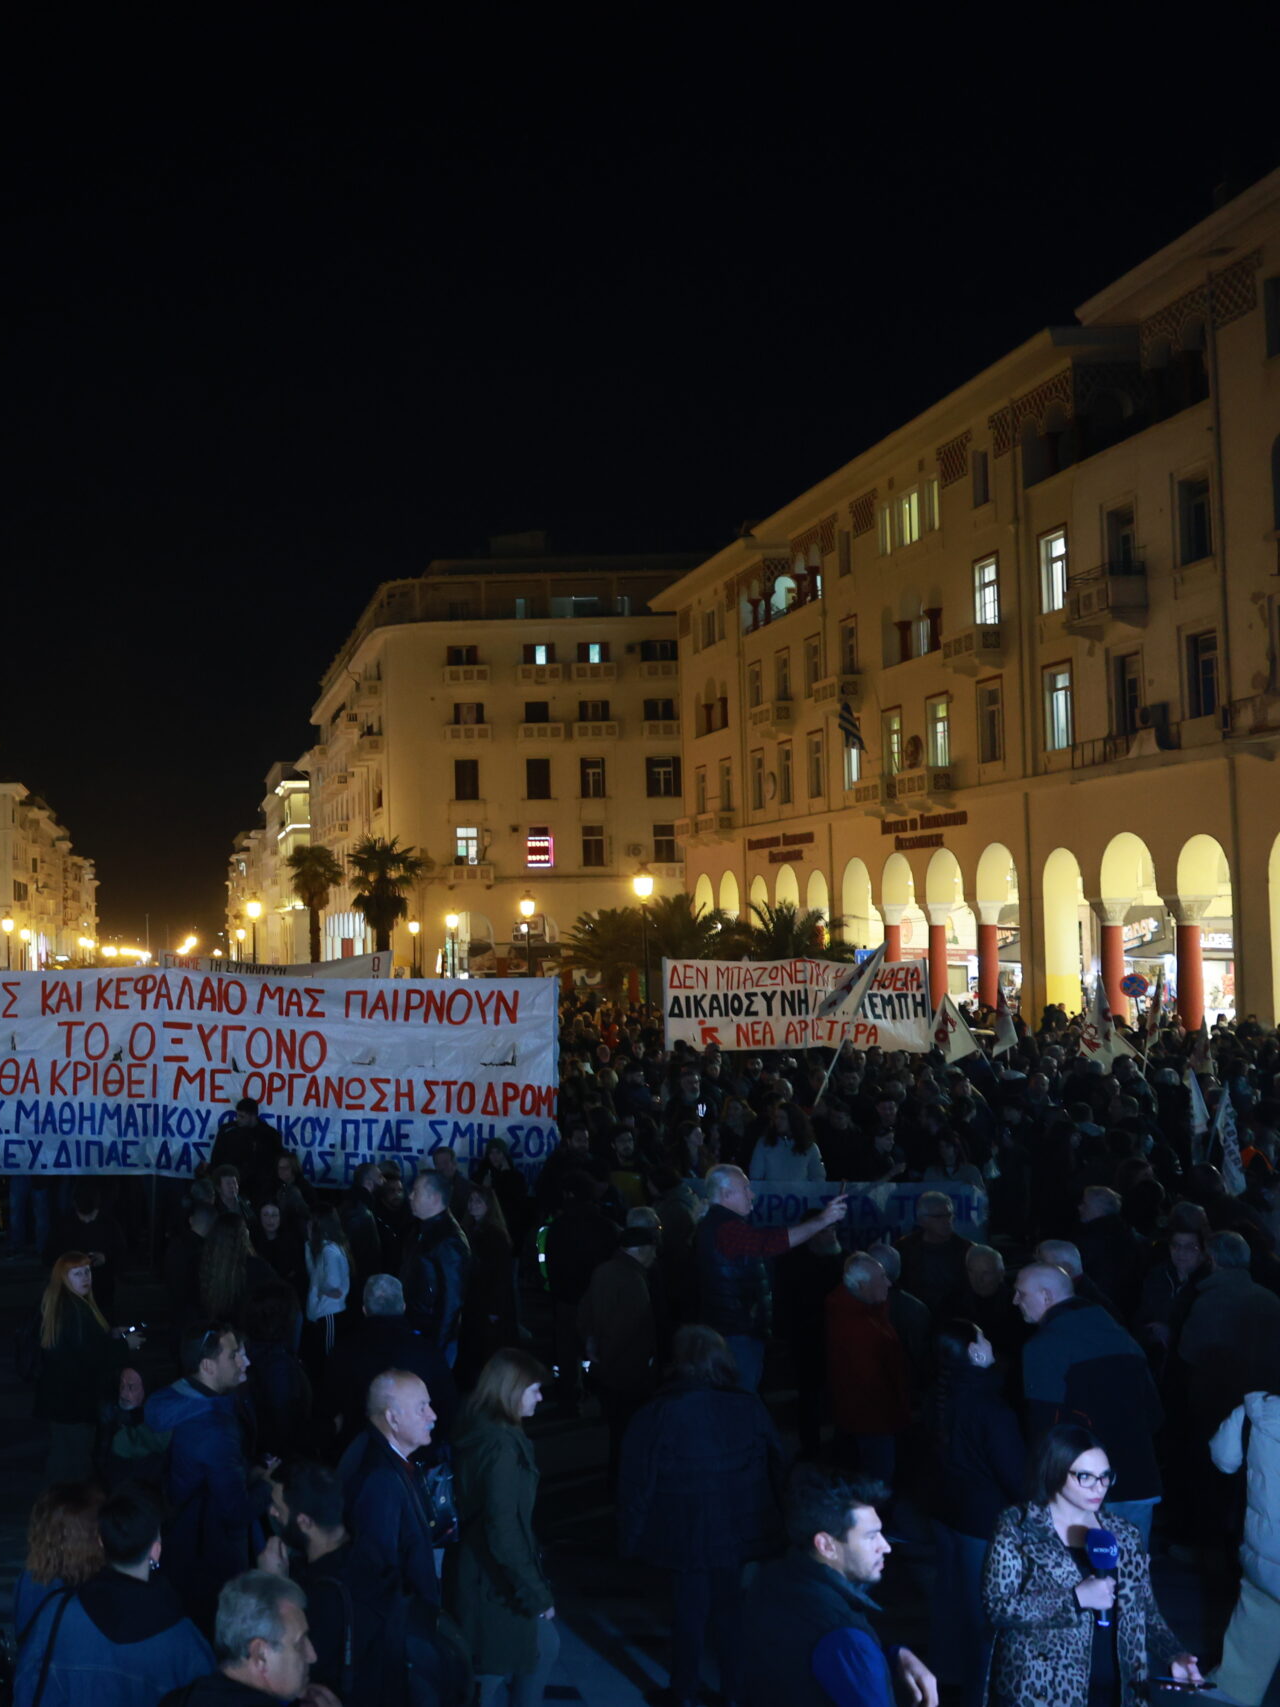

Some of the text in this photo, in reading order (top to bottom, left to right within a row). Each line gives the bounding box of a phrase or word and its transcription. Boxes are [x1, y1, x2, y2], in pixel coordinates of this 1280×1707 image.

[669, 965, 708, 990] ΔΕΝ
[870, 966, 922, 993] ΗΘΕΙΑ
[41, 980, 83, 1016] ΚΑΙ
[95, 974, 247, 1015] ΚΕΦΑΛΑΙΟ
[257, 983, 326, 1018] ΜΑΣ
[344, 988, 519, 1026] ΠΑΙΡΝΟΥΝ
[668, 989, 809, 1019] ΔΙΚΑΙΟΣΥΝΗ
[57, 1021, 328, 1073] ΤΟ ΟΞΥΓΟΝΟ
[735, 1021, 776, 1048] ΝΕΑ
[50, 1060, 158, 1099] ΚΡΙΘΕΙ
[173, 1066, 232, 1103] ΜΕ
[242, 1071, 416, 1113] ΟΡΓΑΝΩΣΗ
[421, 1079, 477, 1115] ΣΤΟ
